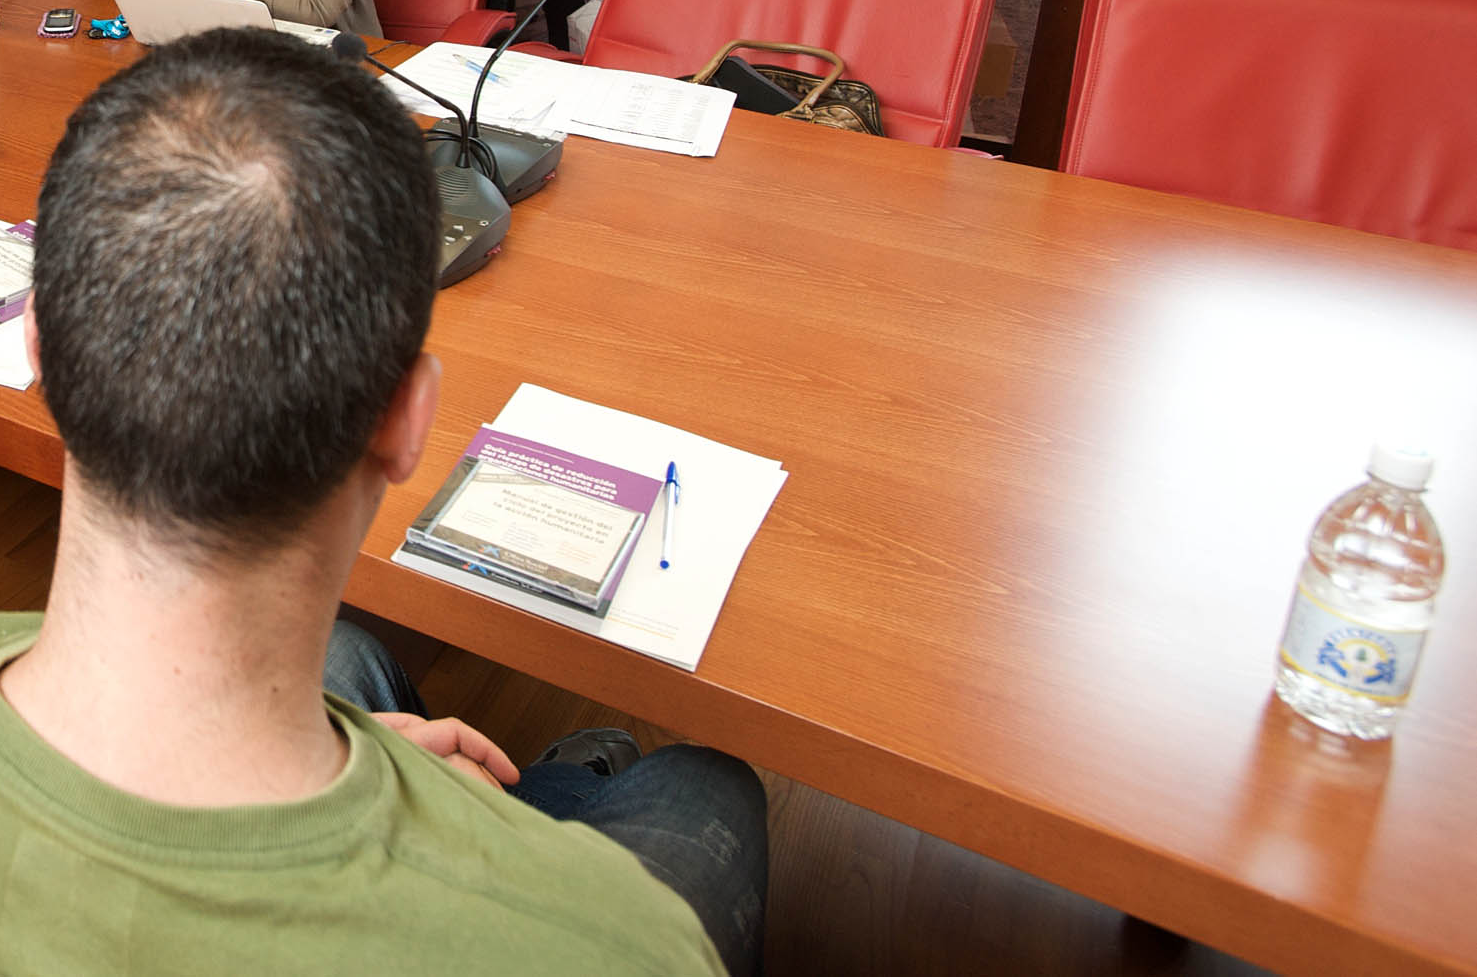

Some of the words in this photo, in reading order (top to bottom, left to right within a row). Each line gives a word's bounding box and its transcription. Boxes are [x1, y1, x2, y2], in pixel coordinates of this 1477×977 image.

[507, 448, 550, 468] práctica
[551, 463, 564, 472] de
[566, 469, 617, 489] reducción
[528, 463, 542, 472] de
